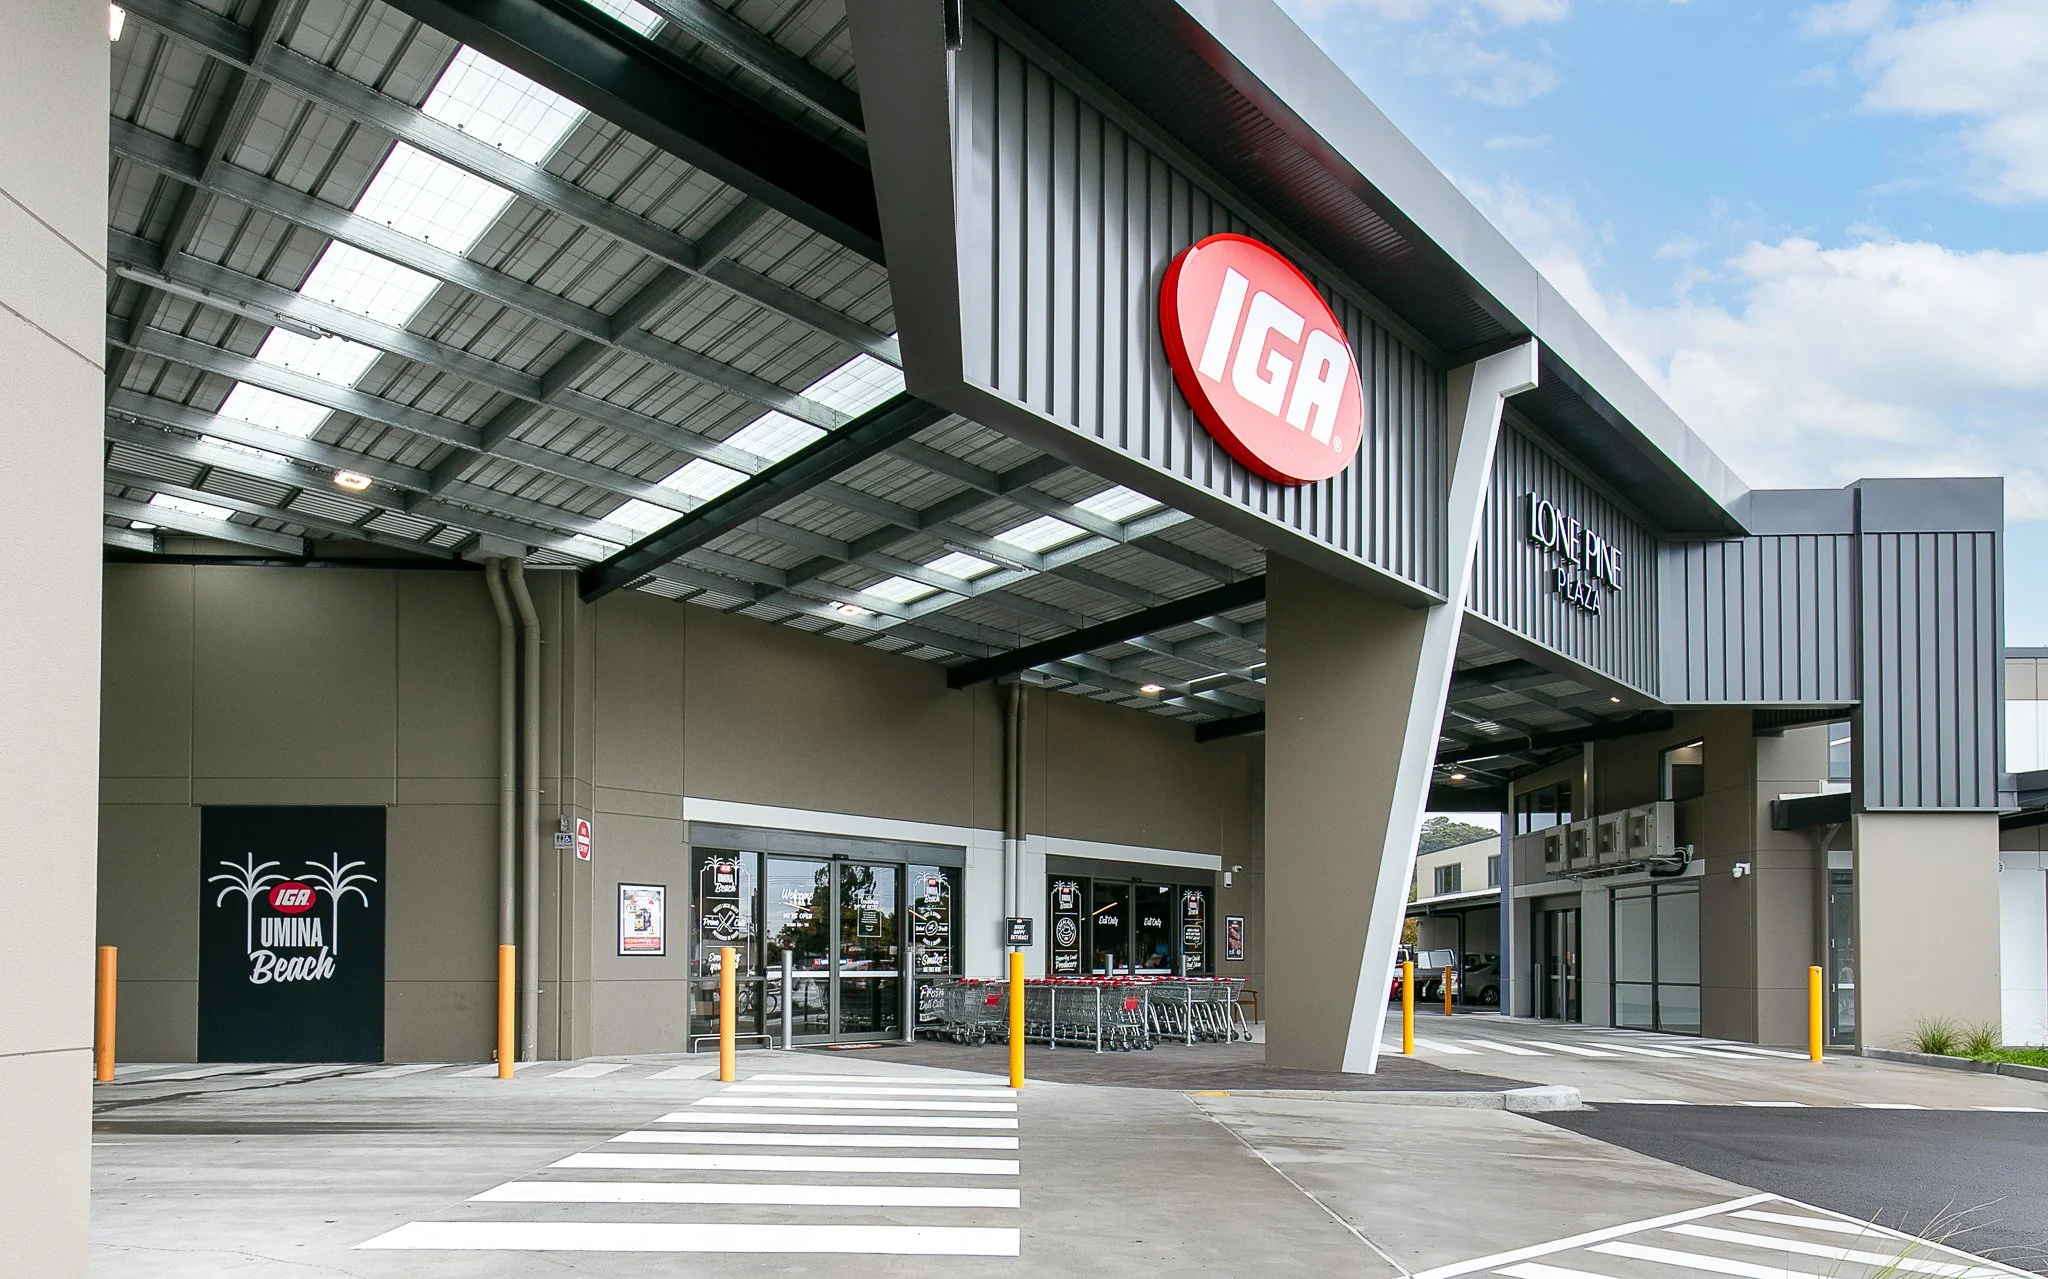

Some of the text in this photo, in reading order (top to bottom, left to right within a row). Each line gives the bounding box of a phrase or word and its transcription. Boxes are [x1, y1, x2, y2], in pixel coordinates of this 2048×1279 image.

[1198, 265, 1351, 446] IGA
[1529, 491, 1622, 591] LONE PINE
[1557, 566, 1601, 616] PLAZA
[274, 888, 311, 906] IGA
[714, 882, 737, 893] Beach
[781, 888, 814, 901] Welcome
[261, 917, 323, 947] UMINA
[249, 945, 336, 985] Beach
[921, 952, 944, 967] Smiles
